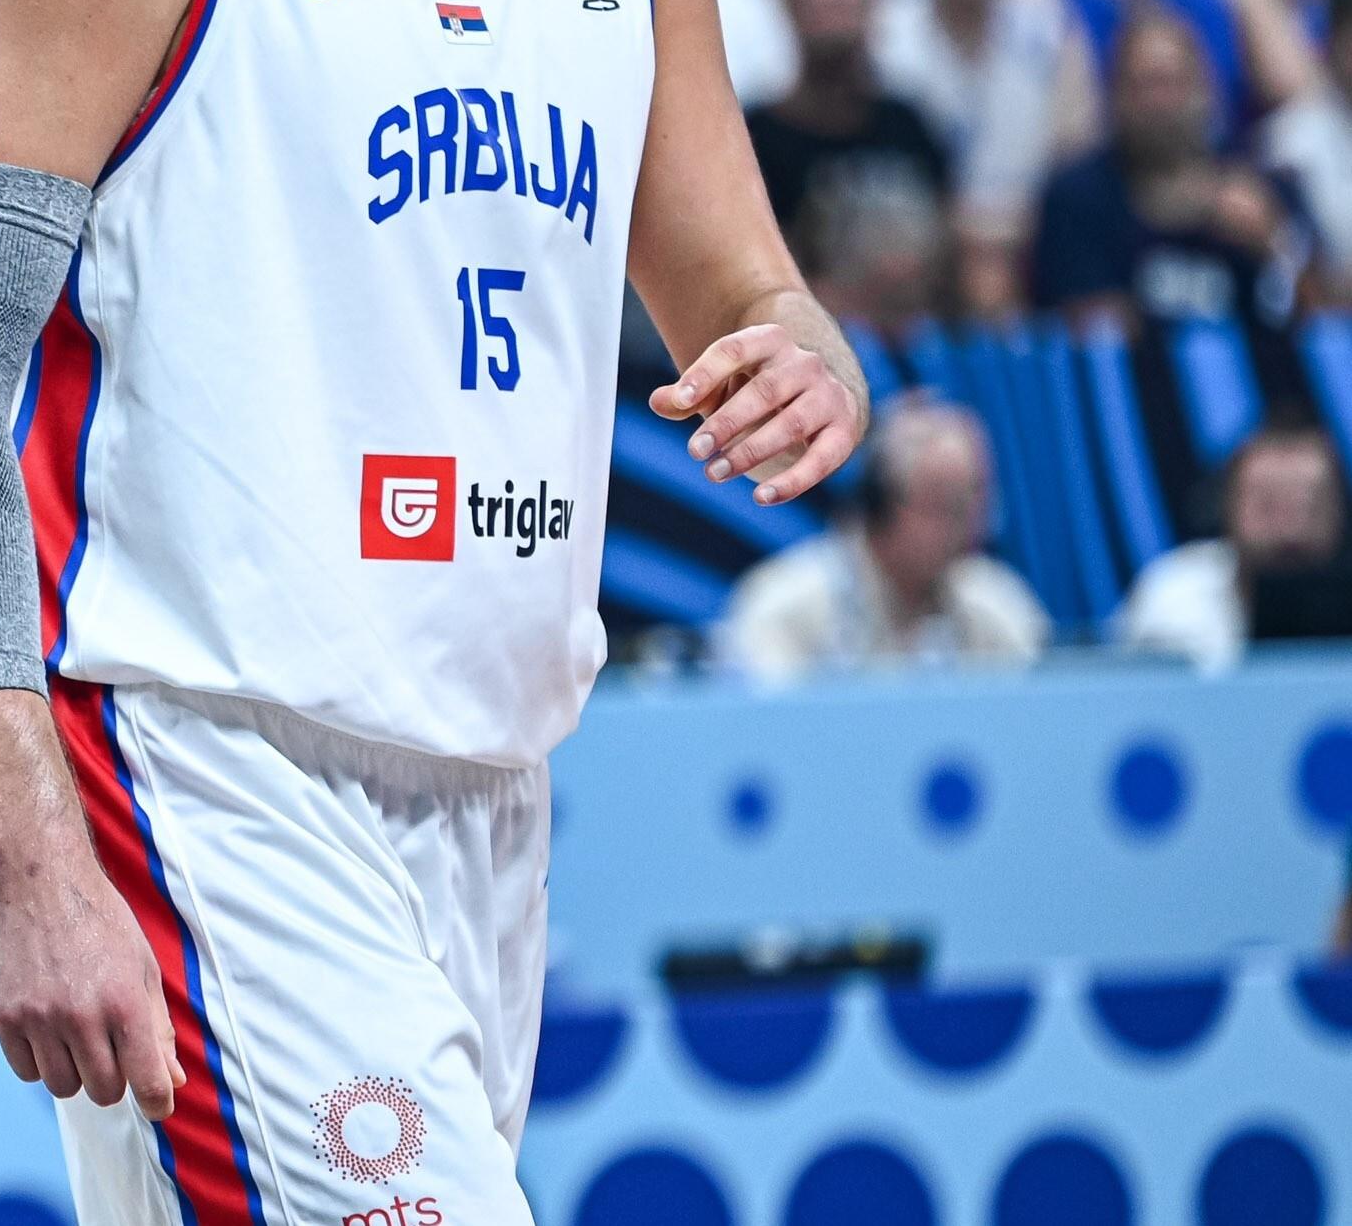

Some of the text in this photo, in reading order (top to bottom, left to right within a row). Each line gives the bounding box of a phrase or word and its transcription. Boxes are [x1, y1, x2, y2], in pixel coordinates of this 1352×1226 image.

[368, 87, 597, 246] SRBIJA
[456, 267, 526, 392] 15
[468, 479, 575, 558] triglav
